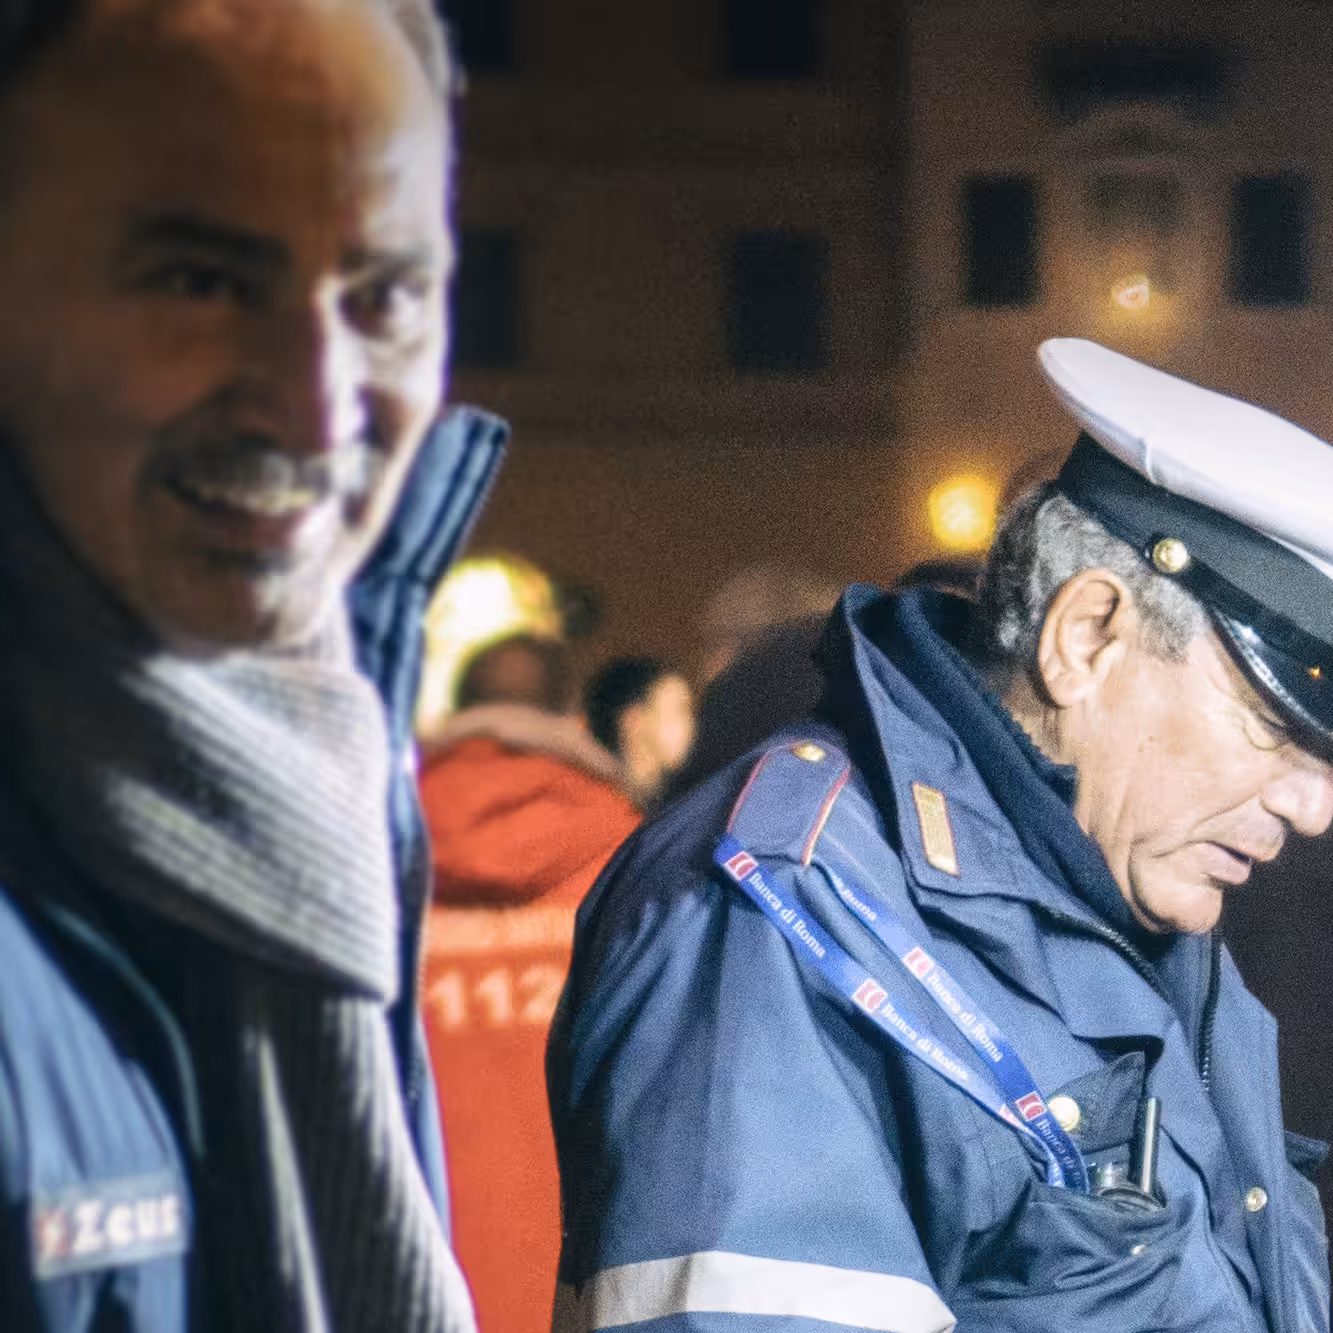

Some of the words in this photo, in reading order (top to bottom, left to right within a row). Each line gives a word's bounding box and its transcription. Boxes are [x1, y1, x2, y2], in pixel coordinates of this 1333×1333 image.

[748, 871, 783, 911] Banca
[780, 908, 798, 924] di
[792, 919, 827, 958] Roma
[880, 1002, 918, 1042] Banca
[972, 1023, 1003, 1063] Roma
